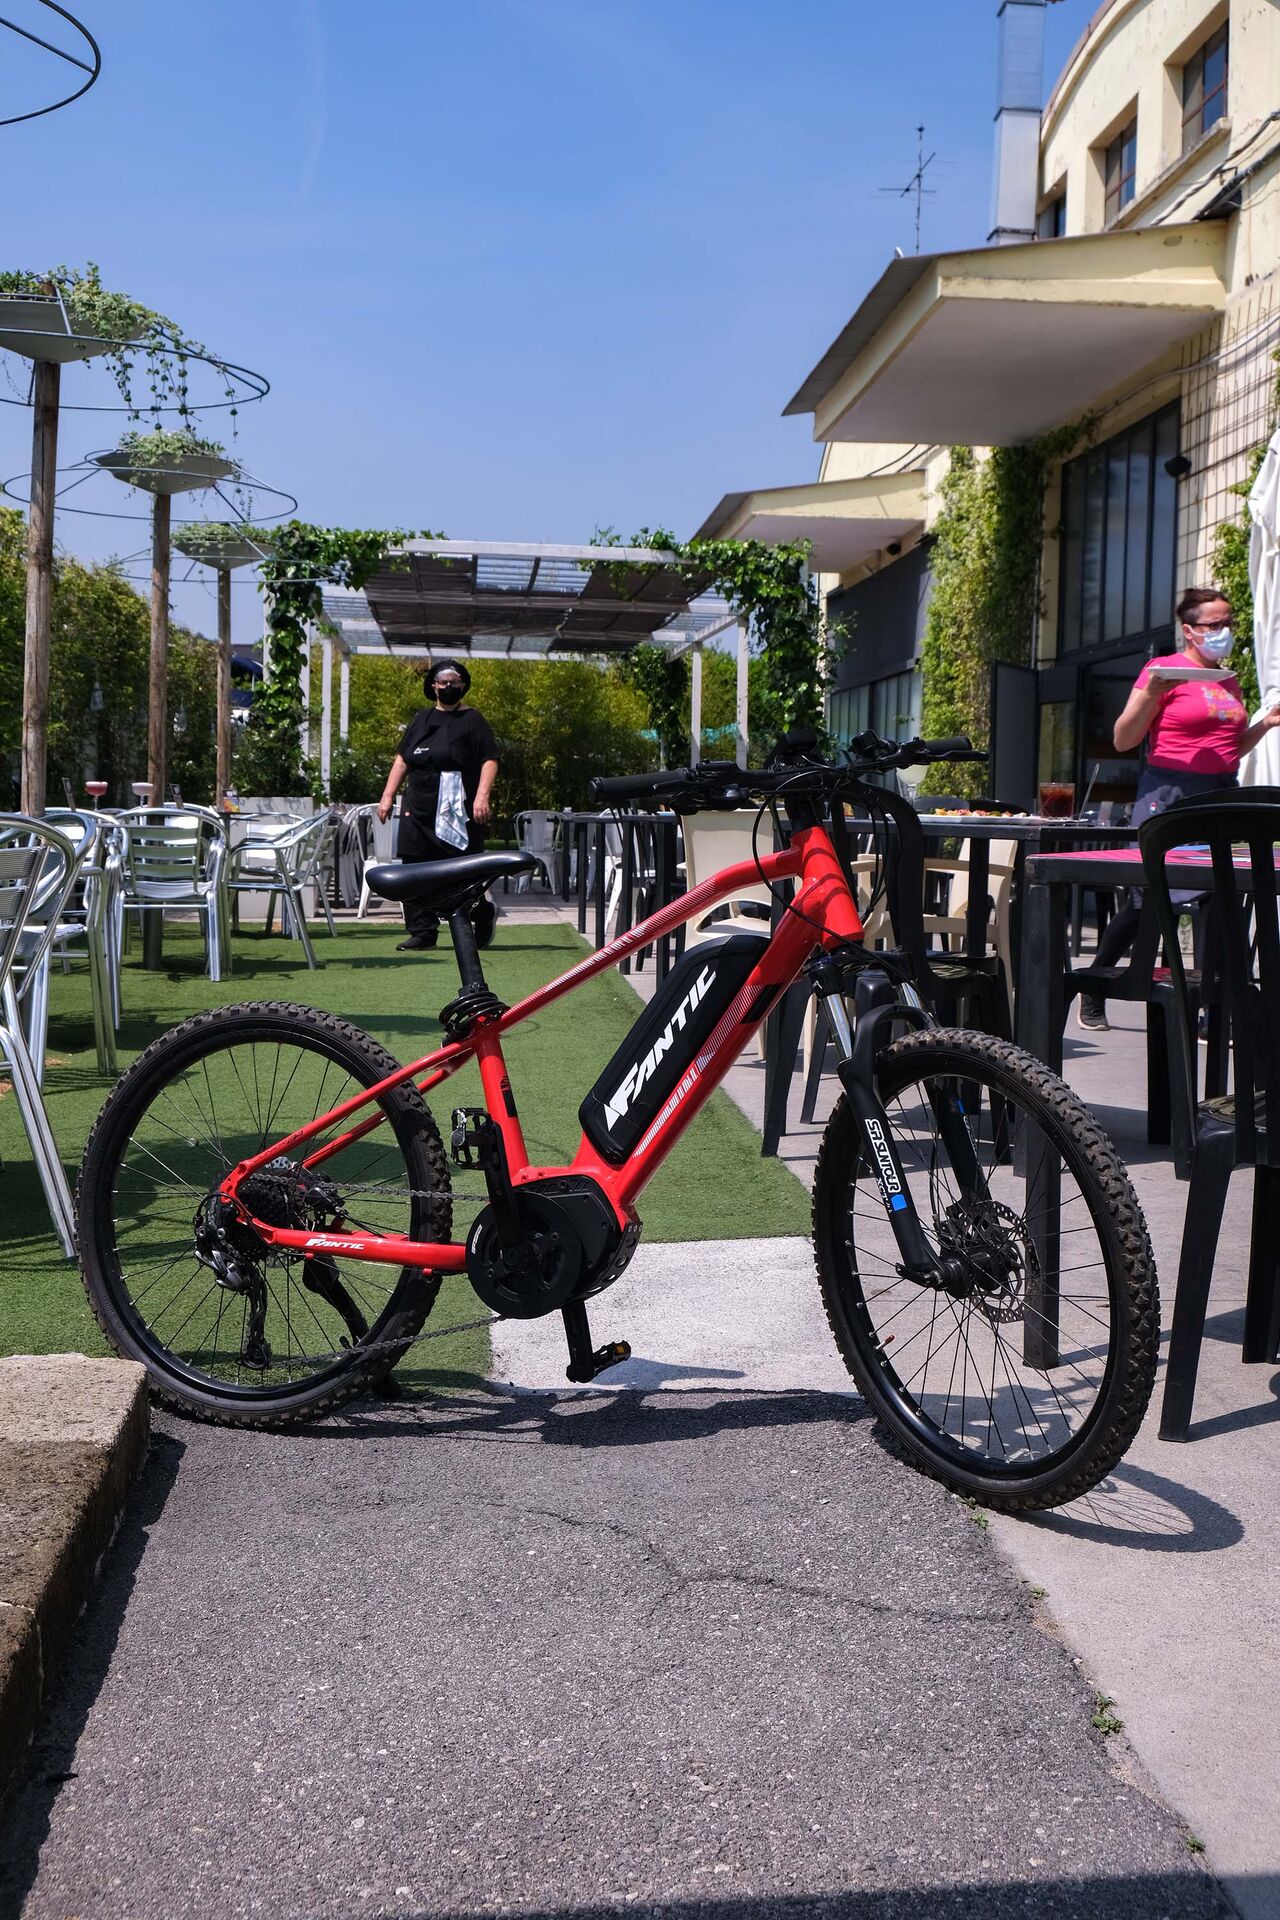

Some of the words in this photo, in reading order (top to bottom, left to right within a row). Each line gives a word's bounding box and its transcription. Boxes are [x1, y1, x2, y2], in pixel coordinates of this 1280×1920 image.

[604, 965, 717, 1132] FANTIC
[873, 1140, 901, 1193] SUNTOUR
[305, 1238, 365, 1250] FANTIC
